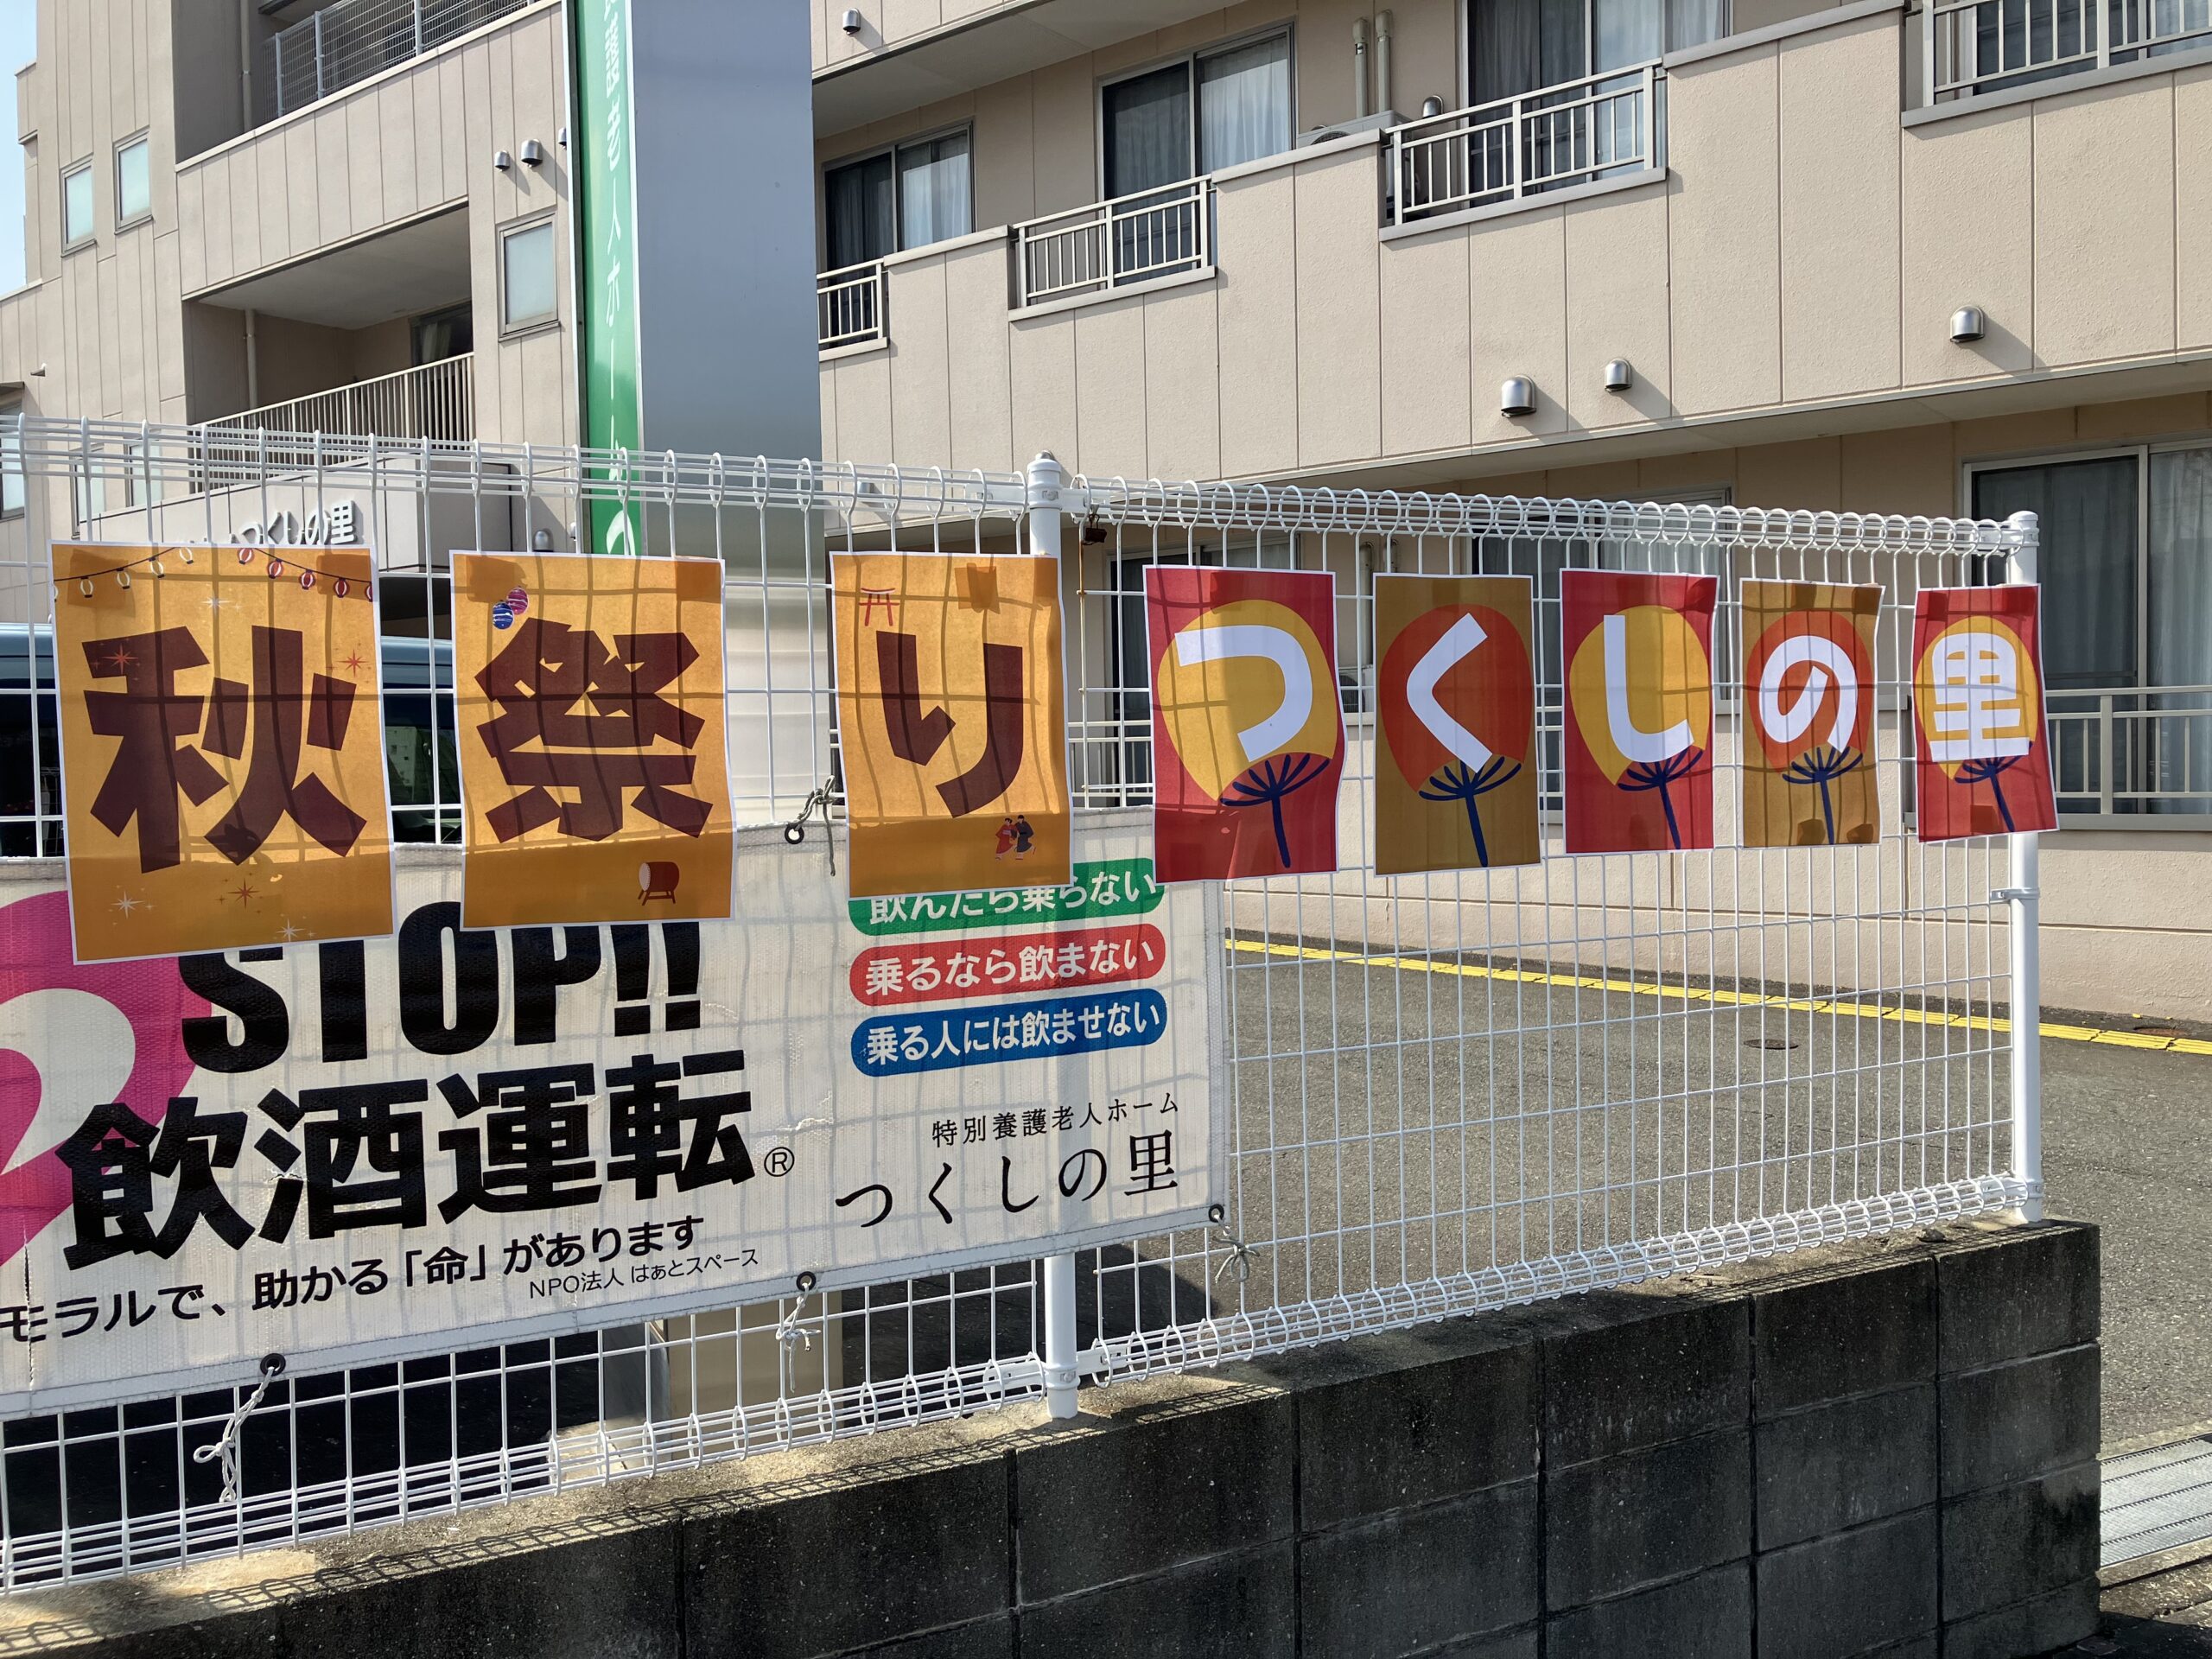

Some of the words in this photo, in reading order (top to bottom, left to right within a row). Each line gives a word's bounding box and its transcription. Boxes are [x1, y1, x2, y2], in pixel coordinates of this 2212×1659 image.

[866, 939, 1154, 996] 乗るなら飲まない
[867, 1000, 1160, 1065] 乗る人には飲ませない
[931, 1092, 1179, 1147] 特別養護老人ホーム
[56, 1051, 756, 1270] 飲酒運転
[835, 1129, 1178, 1228] つくしの里
